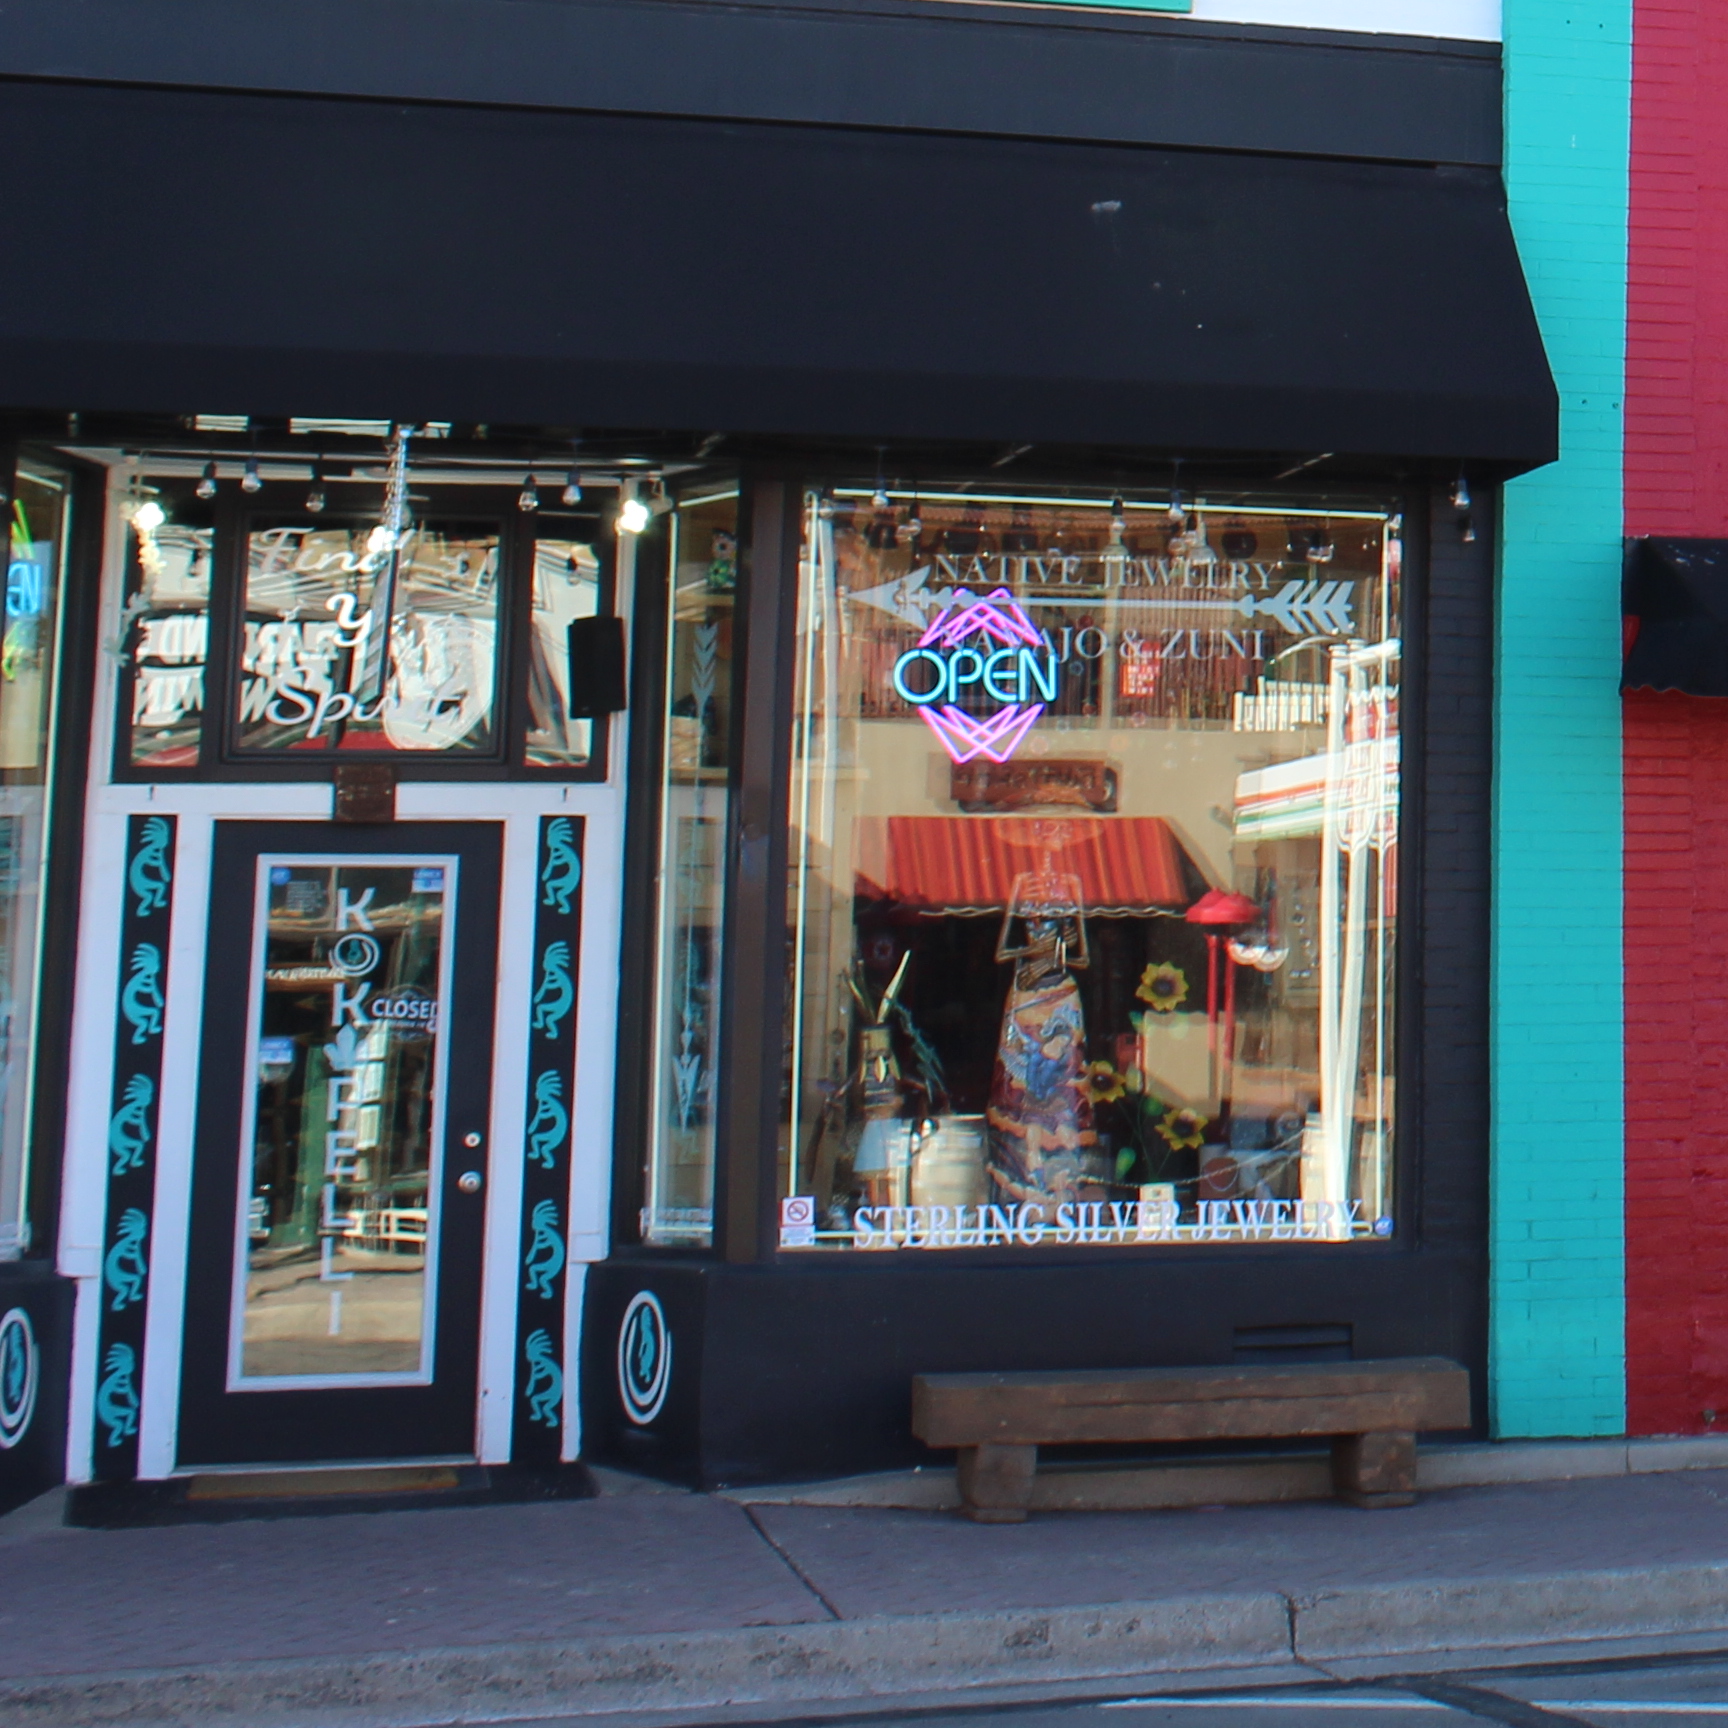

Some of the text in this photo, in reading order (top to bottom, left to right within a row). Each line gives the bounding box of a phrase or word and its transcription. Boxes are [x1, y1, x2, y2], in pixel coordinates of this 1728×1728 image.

[934, 553, 1280, 592] NATIVE JEWELRY
[1119, 628, 1146, 659] &
[1159, 628, 1265, 660] ZUNI
[893, 647, 1058, 704] OPEN
[853, 1202, 1046, 1250] STERLING
[1054, 1198, 1184, 1245] SILVER
[1190, 1197, 1364, 1241] JEWELRY
